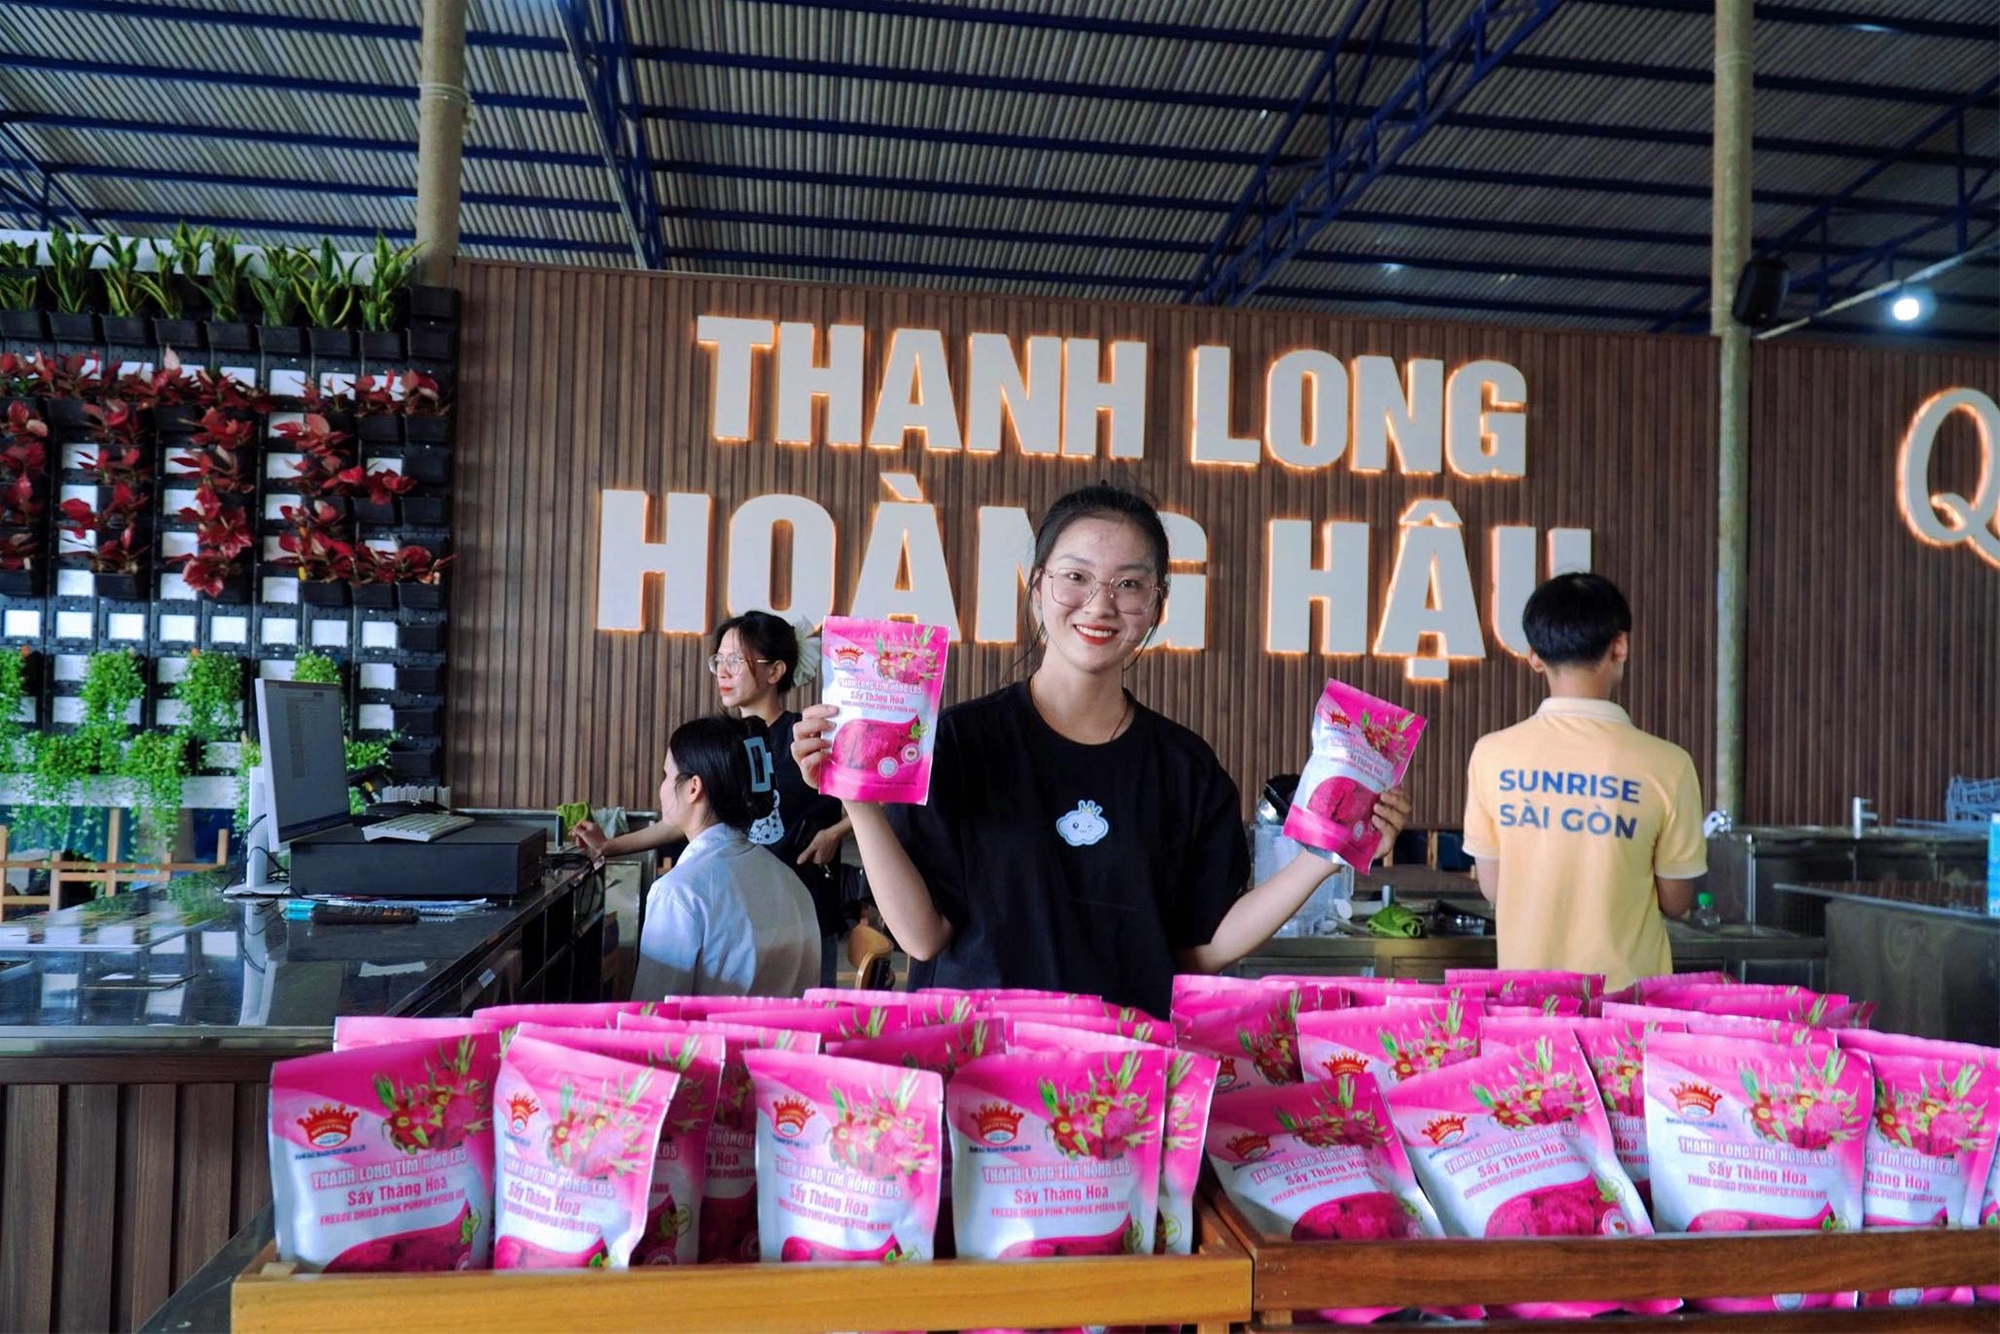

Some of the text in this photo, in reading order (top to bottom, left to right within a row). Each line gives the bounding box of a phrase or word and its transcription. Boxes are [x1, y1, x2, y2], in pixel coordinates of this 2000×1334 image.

[697, 315, 1527, 478] THANH LONG
[1266, 499, 1592, 682] HẬU
[1499, 769, 1642, 804] SUNRISE
[1499, 799, 1637, 839] SÀI GÒN
[715, 1152, 739, 1167] Hoa
[1478, 1161, 1501, 1178] Sấy
[1541, 1141, 1567, 1156] Hoa
[1679, 1137, 1716, 1156] THANH
[1719, 1141, 1751, 1160] LONG
[983, 1165, 1022, 1183] THANH
[1025, 1163, 1055, 1182] LONG
[1445, 1150, 1481, 1175] THANH
[1708, 1159, 1733, 1179] Sấy
[1781, 1169, 1807, 1185] Hoa
[312, 1168, 355, 1189] THANH
[359, 1163, 391, 1182] LONG
[1904, 1174, 1930, 1191] Hoa
[347, 1185, 374, 1206] Sấy
[425, 1176, 447, 1192] Hoa
[1014, 1186, 1039, 1205] Sấy
[1086, 1184, 1109, 1199] Hoa
[554, 1196, 581, 1216] Hoa
[844, 1197, 869, 1217] Hoa
